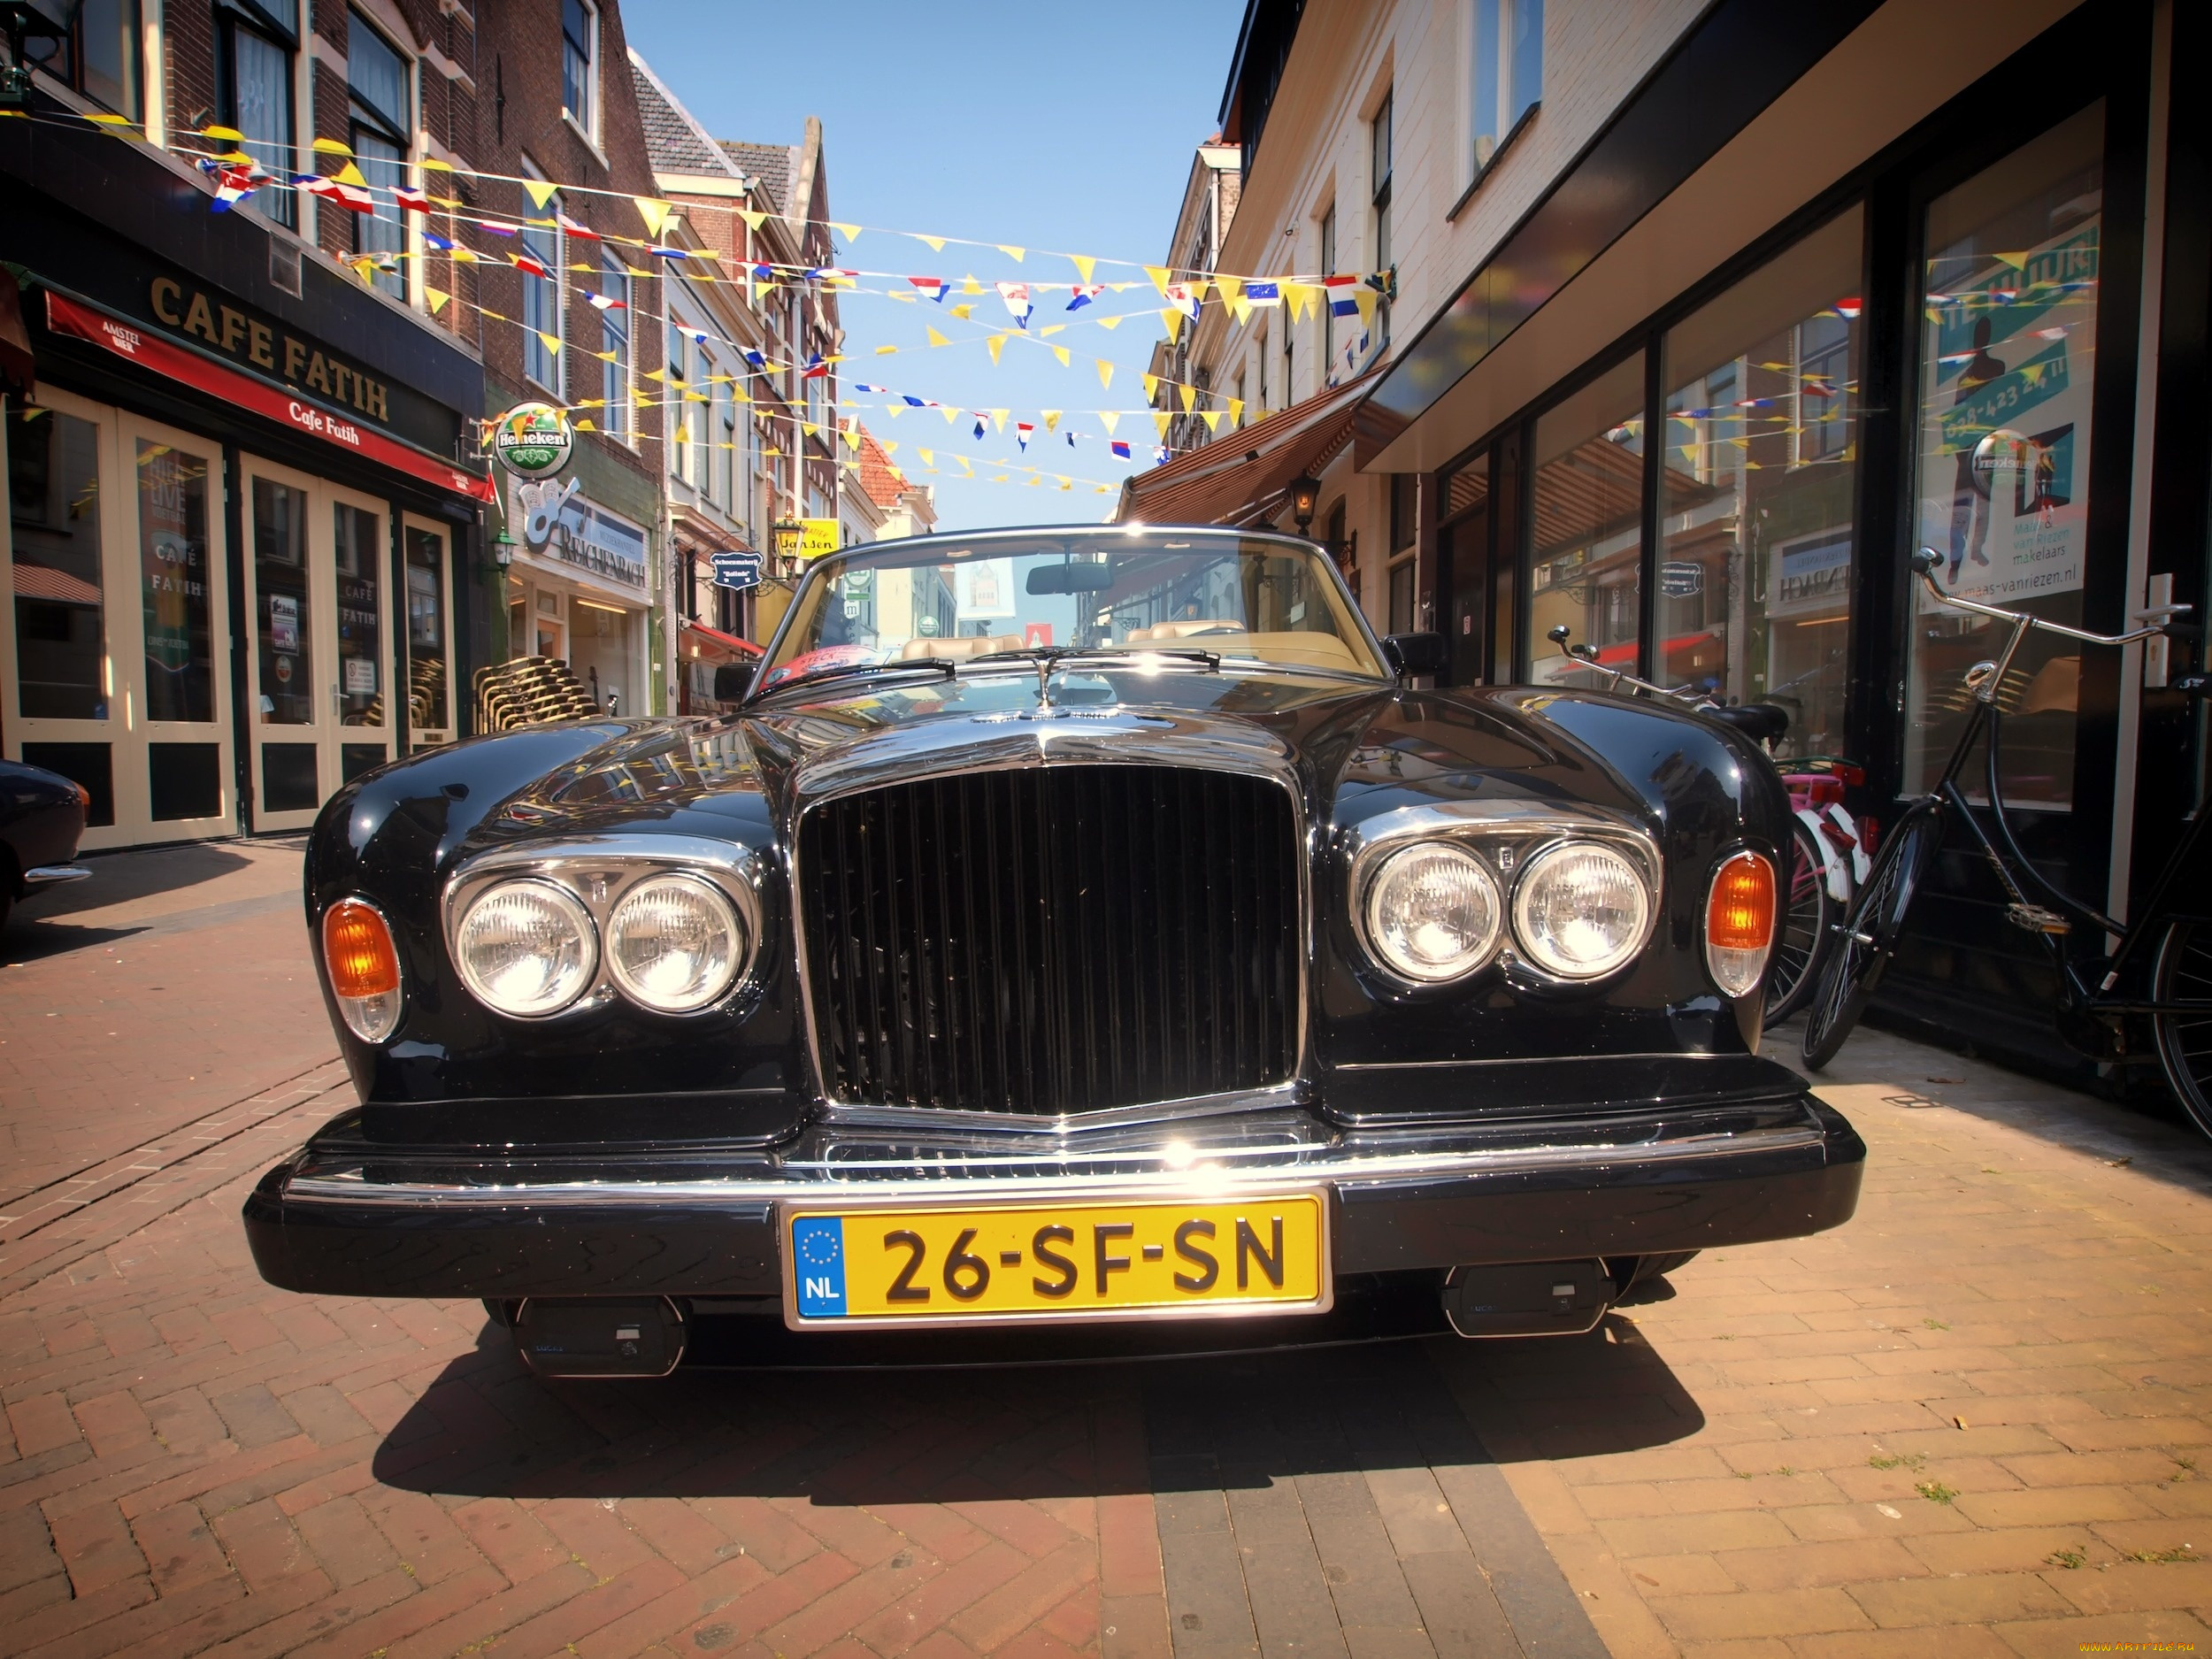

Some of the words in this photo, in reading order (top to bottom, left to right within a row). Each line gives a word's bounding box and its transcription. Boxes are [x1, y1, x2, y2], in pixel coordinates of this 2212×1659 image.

[1987, 240, 2089, 311] HUUR
[103, 320, 142, 346] AMSTEL
[111, 334, 135, 354] BIER
[150, 276, 274, 370] CAFE
[284, 336, 389, 422] FATIH
[288, 401, 323, 432] Cafe
[326, 417, 360, 446] Fatih
[1947, 385, 2019, 439] 038-423
[150, 479, 187, 513] LIVE
[2044, 514, 2054, 528] &
[781, 539, 833, 549] Jansen
[2013, 537, 2034, 549] van
[2036, 527, 2070, 545] Riezen
[558, 522, 646, 588] REICHENBACH
[2012, 545, 2066, 565] makelaars
[151, 574, 202, 597] FATIH
[345, 586, 373, 602] CAFÉ
[1934, 563, 2077, 604] w.maas-vanriezen.nl
[342, 609, 376, 626] FATIH
[800, 651, 835, 664] STECK
[883, 1215, 1285, 1305] 26-SF-SN
[805, 1276, 840, 1300] NL
